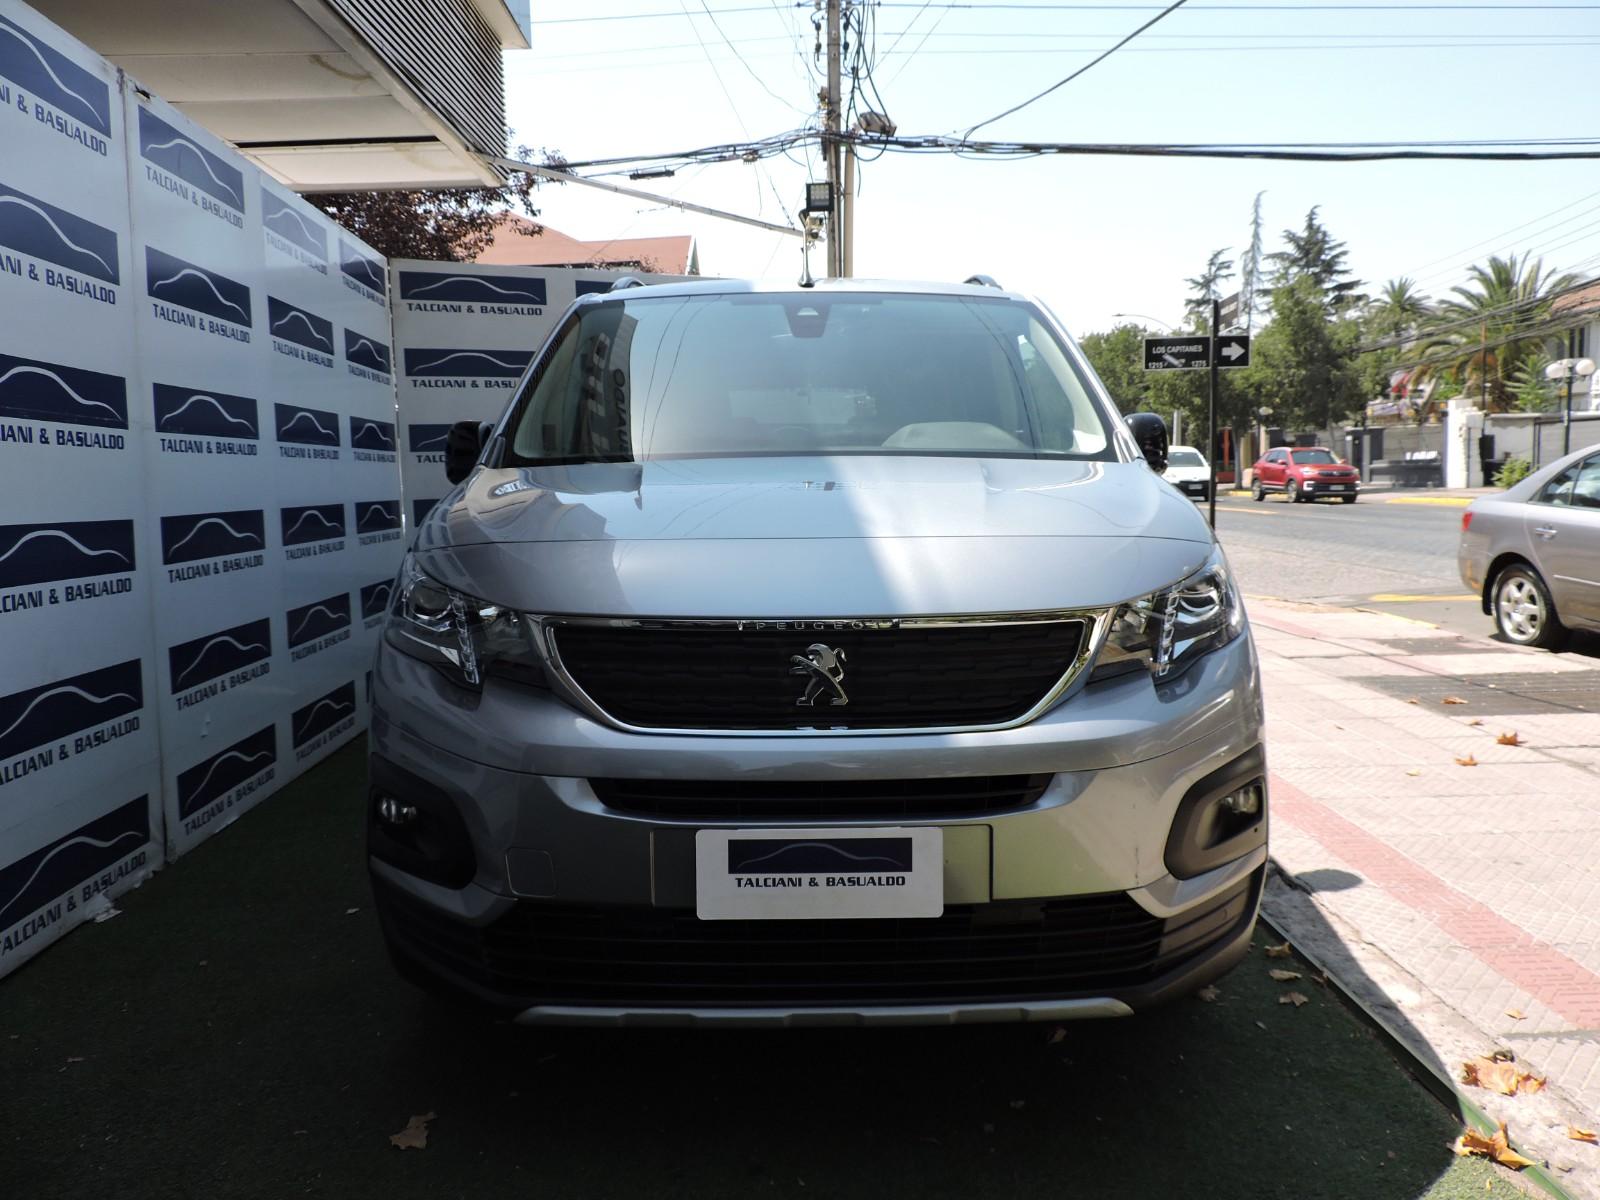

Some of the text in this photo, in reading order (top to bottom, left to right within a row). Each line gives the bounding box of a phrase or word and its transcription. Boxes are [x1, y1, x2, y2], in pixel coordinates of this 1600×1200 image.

[17, 94, 28, 114] &
[35, 103, 107, 156] BASUALDO
[145, 165, 188, 200] TALCIANI
[201, 196, 243, 229] BASUALDO
[28, 263, 40, 281] &
[46, 268, 116, 305] BASUALDO
[407, 302, 543, 316] TALCIANI & BASUALDO
[153, 303, 250, 344] TALCIANI & BASUALDO
[1152, 345, 1203, 354] LOS CAPITANES
[411, 379, 466, 389] TALCIANI
[471, 380, 479, 389] &
[39, 428, 50, 445] &
[56, 429, 125, 450] BASUALDO
[160, 438, 258, 456] TALCIANI & BASUALDO
[168, 563, 211, 584] TALCIANI
[223, 555, 264, 573] BASUALDO
[48, 588, 59, 605] &
[65, 578, 132, 602] BASUALDO
[58, 744, 69, 761] &
[74, 716, 140, 755] BASUALDO
[735, 876, 906, 888] TALCIANI & BASUALDO
[0, 851, 146, 956] ALCIANI & BASUALDO
